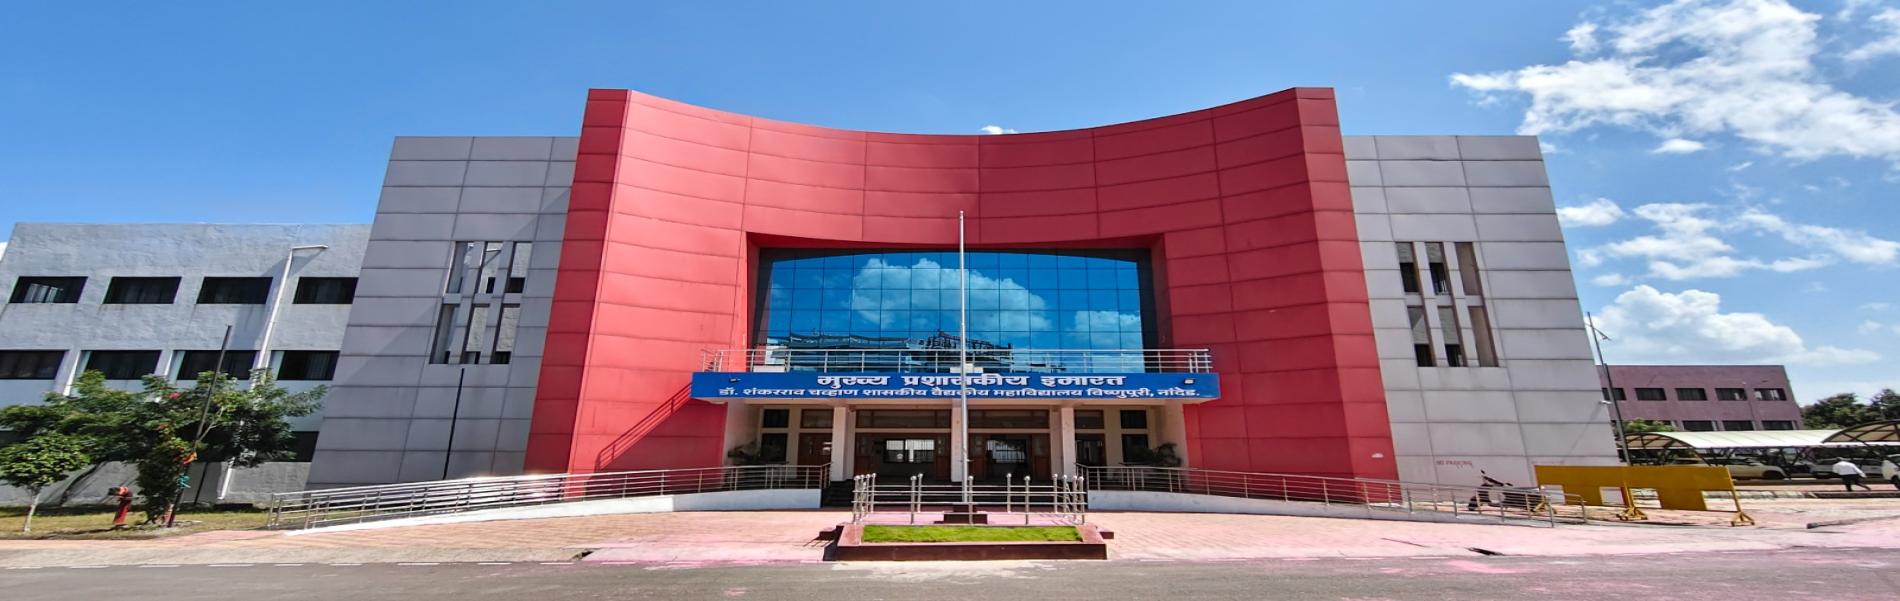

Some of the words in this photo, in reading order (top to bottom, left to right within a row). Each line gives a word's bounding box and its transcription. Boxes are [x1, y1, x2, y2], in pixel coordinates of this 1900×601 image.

[817, 375, 891, 389] मुख्य
[901, 373, 1031, 387] प्रशासकीय
[1040, 375, 1126, 387] इमारत
[719, 387, 738, 396] डॉ.
[743, 387, 805, 396] शंकरराव
[808, 387, 859, 397] चव्हाण
[862, 387, 927, 396] शासकीय
[993, 387, 1083, 397] महाविद्यालय
